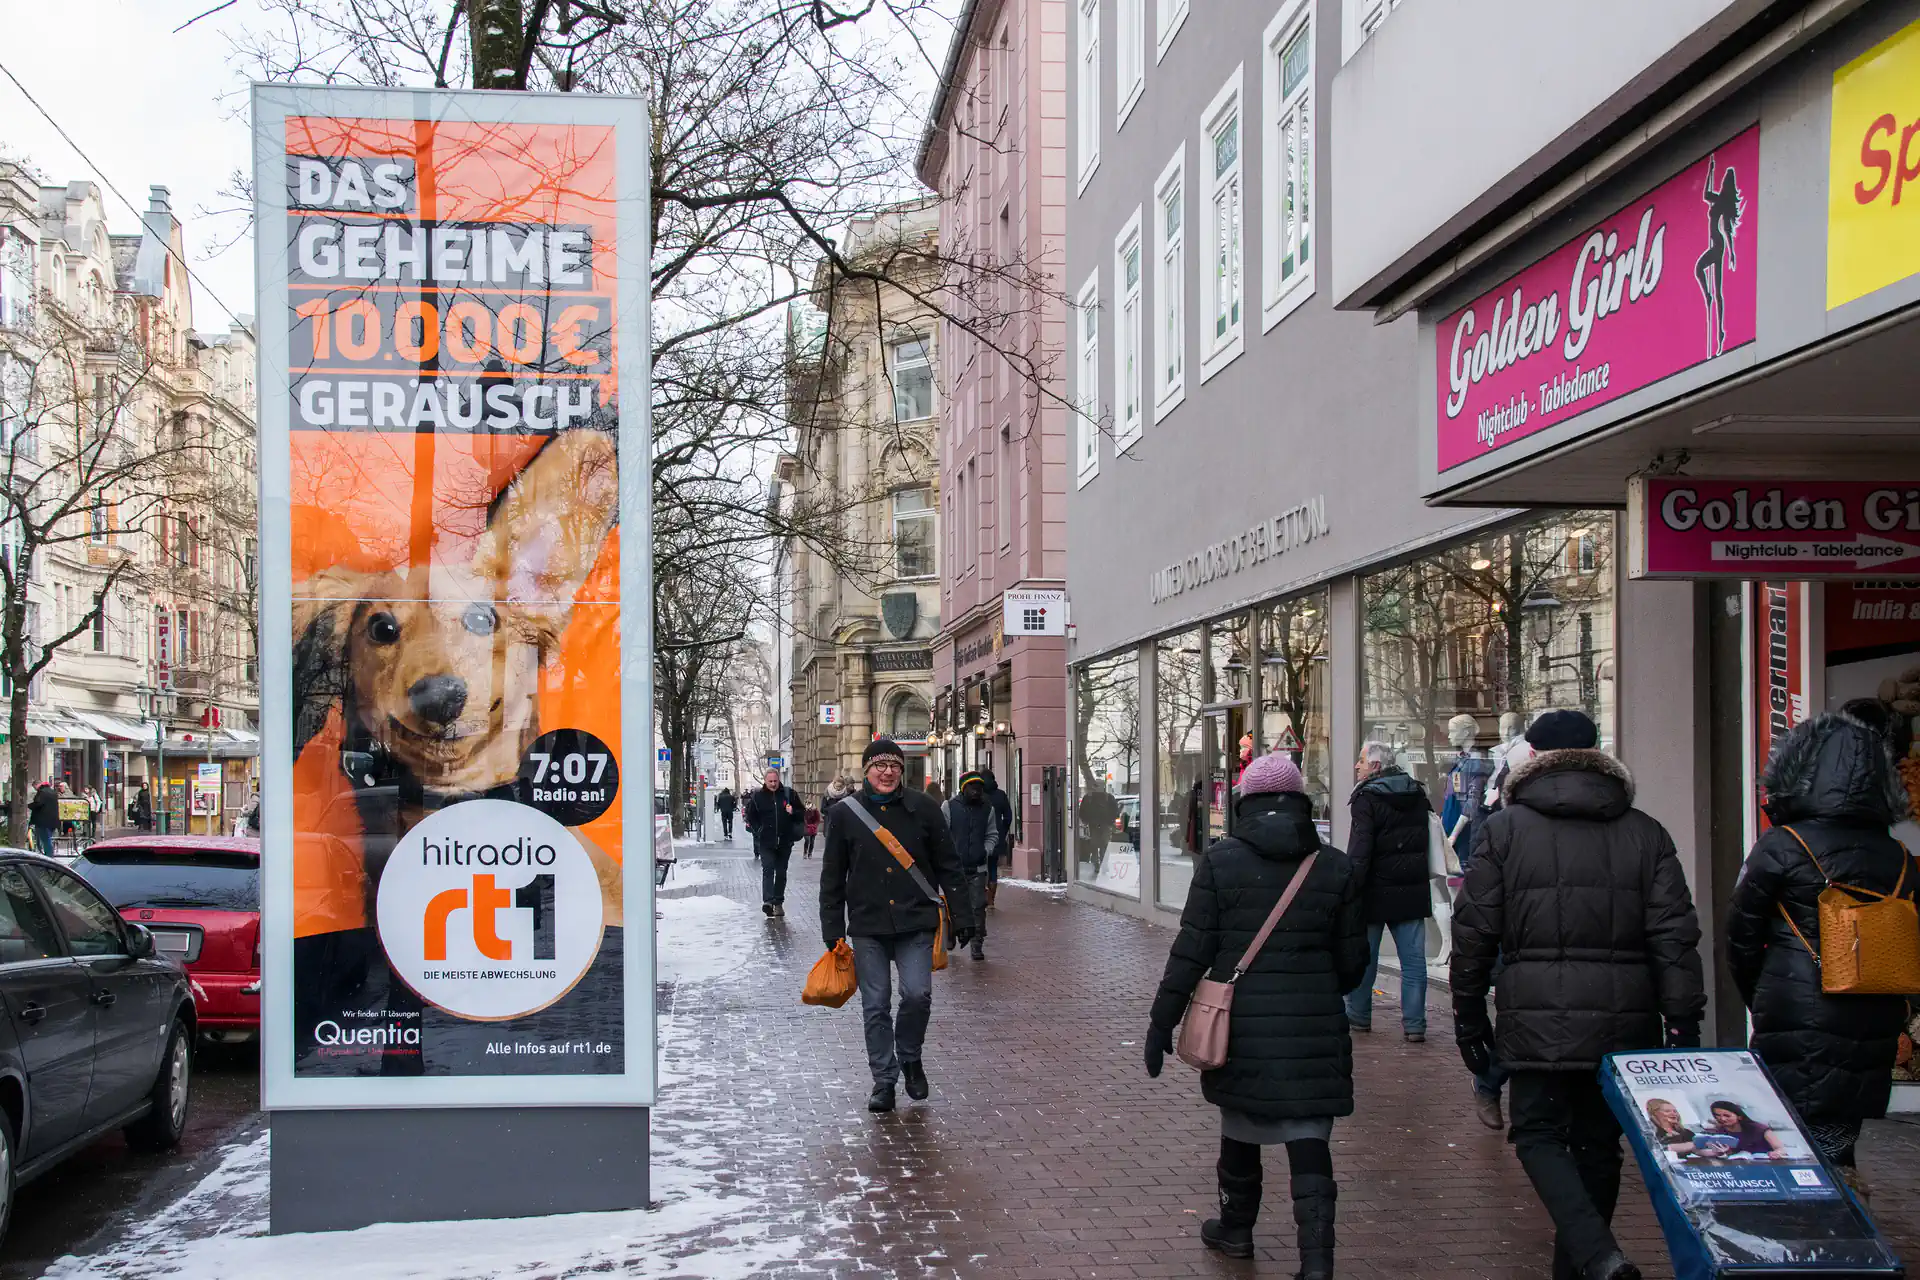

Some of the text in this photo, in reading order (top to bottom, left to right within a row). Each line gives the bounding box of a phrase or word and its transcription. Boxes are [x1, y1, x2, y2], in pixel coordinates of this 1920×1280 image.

[1854, 113, 1920, 208] Sp
[299, 160, 407, 208] DAS
[298, 224, 584, 285] GEHEIME
[1446, 204, 1666, 418] Golden Girls
[296, 298, 600, 366] 10.000€
[300, 378, 593, 430] GERÄUSCH
[1477, 391, 1529, 447] Nightclub
[1539, 362, 1610, 415] Tabledance
[1661, 488, 1920, 532] Golden Gi
[1725, 543, 1798, 559] Nightclub
[1812, 544, 1904, 557] Tabledance
[1150, 560, 1184, 604] UNITED
[1186, 540, 1229, 590] COLORS
[1231, 531, 1248, 573] OF
[1852, 599, 1905, 620] India
[530, 753, 607, 784] 7:07
[533, 788, 605, 802] Radio an!
[423, 837, 556, 866] hitradio
[423, 874, 556, 961] rt1
[424, 970, 556, 981] DIE MEISTE ABWECHSLUNG
[342, 1009, 420, 1019] Wir finden IT Lösungen
[314, 1020, 420, 1045] Quentia
[486, 1042, 612, 1054] Alle Infos auf rt1.de
[1626, 1058, 1712, 1074] GRATIS
[1634, 1074, 1719, 1085] BIBELKURS
[1685, 1171, 1735, 1180] TERMINE
[1724, 1179, 1776, 1188] WUNSCH
